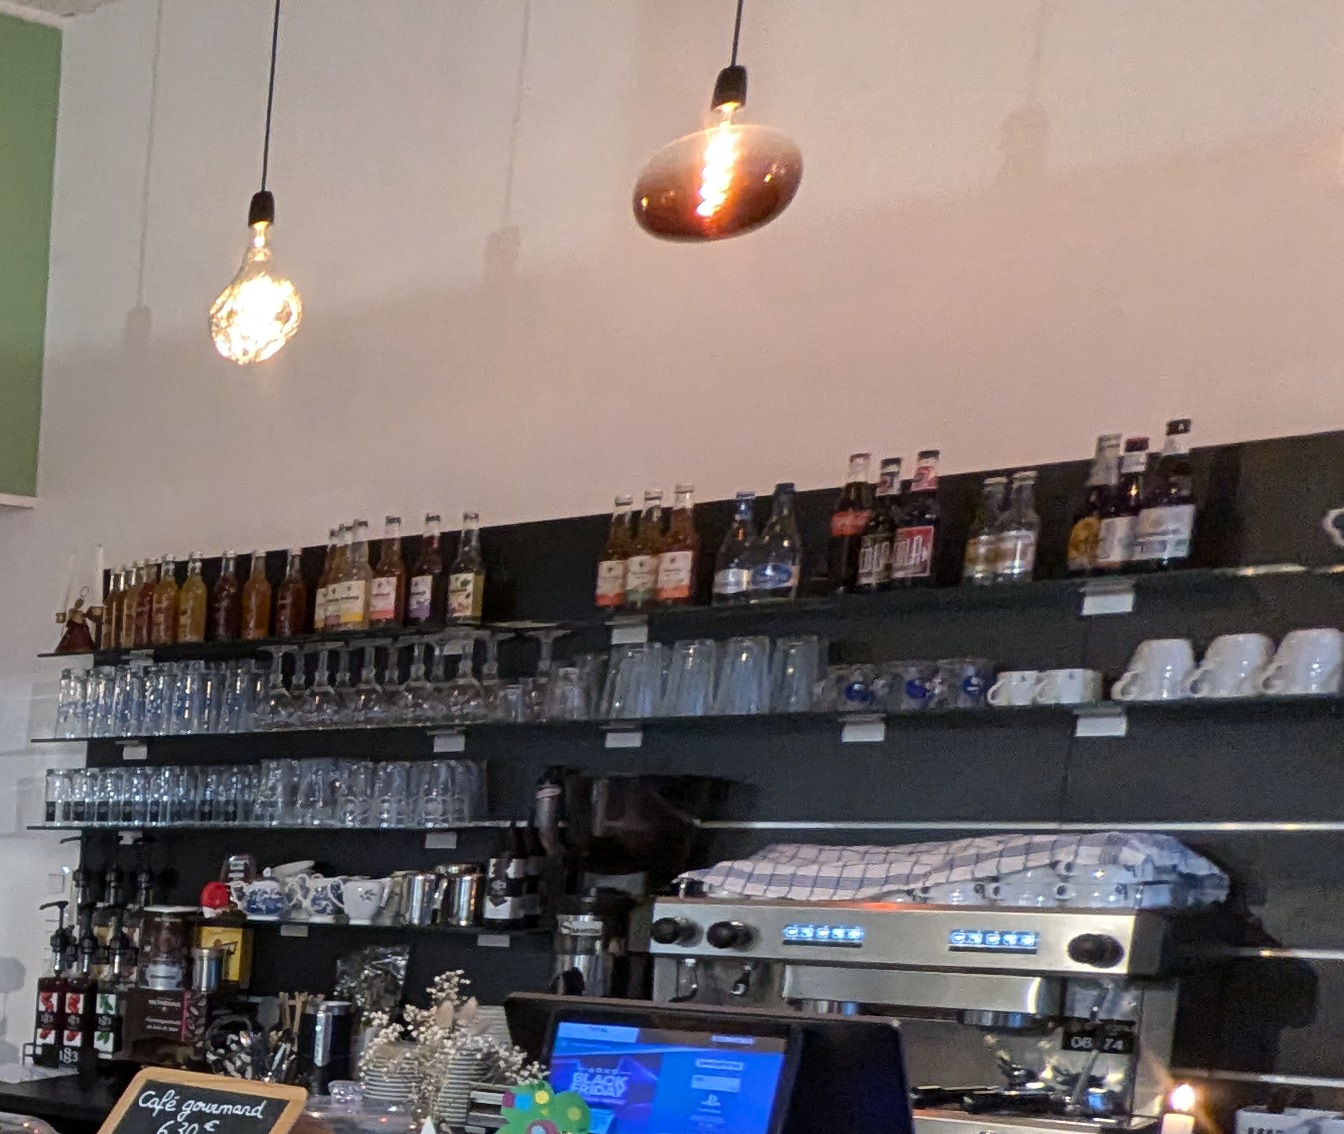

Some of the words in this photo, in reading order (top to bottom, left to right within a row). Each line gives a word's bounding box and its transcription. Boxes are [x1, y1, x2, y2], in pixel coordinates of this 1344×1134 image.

[573, 1072, 629, 1089] BLACK
[138, 1089, 180, 1117] Café
[177, 1099, 267, 1122] gourmand
